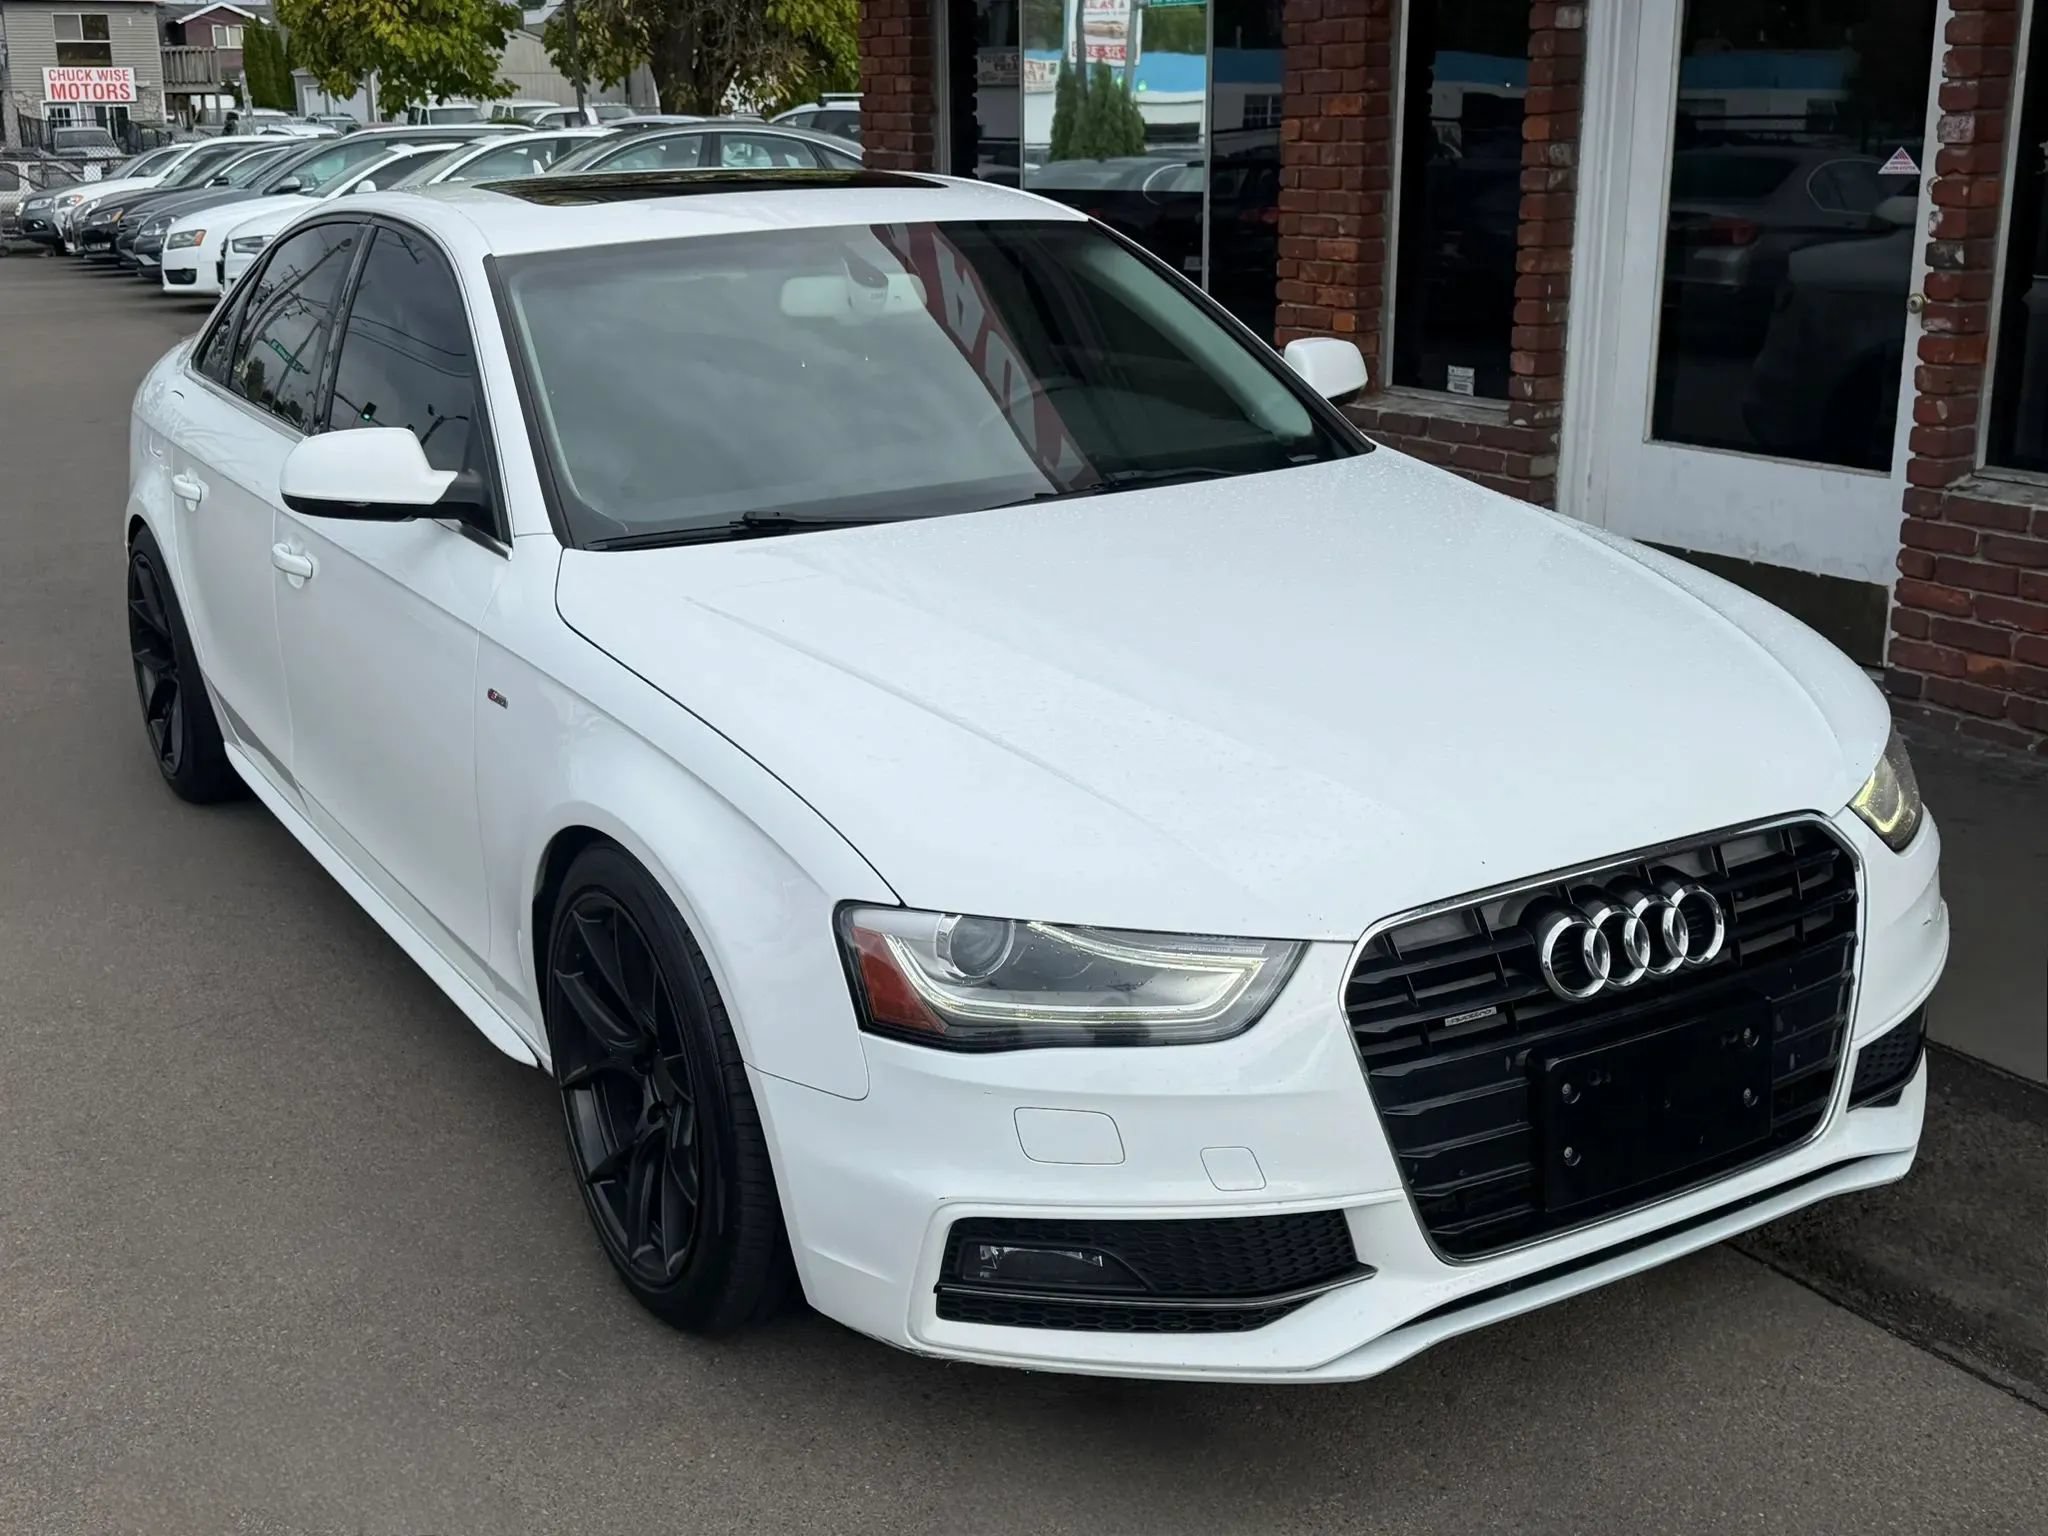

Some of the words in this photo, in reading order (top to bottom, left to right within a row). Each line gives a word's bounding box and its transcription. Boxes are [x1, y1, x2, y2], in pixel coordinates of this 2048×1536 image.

[48, 69, 93, 81] CHUCK
[96, 69, 130, 81] WISE
[50, 83, 131, 100] MOTORS
